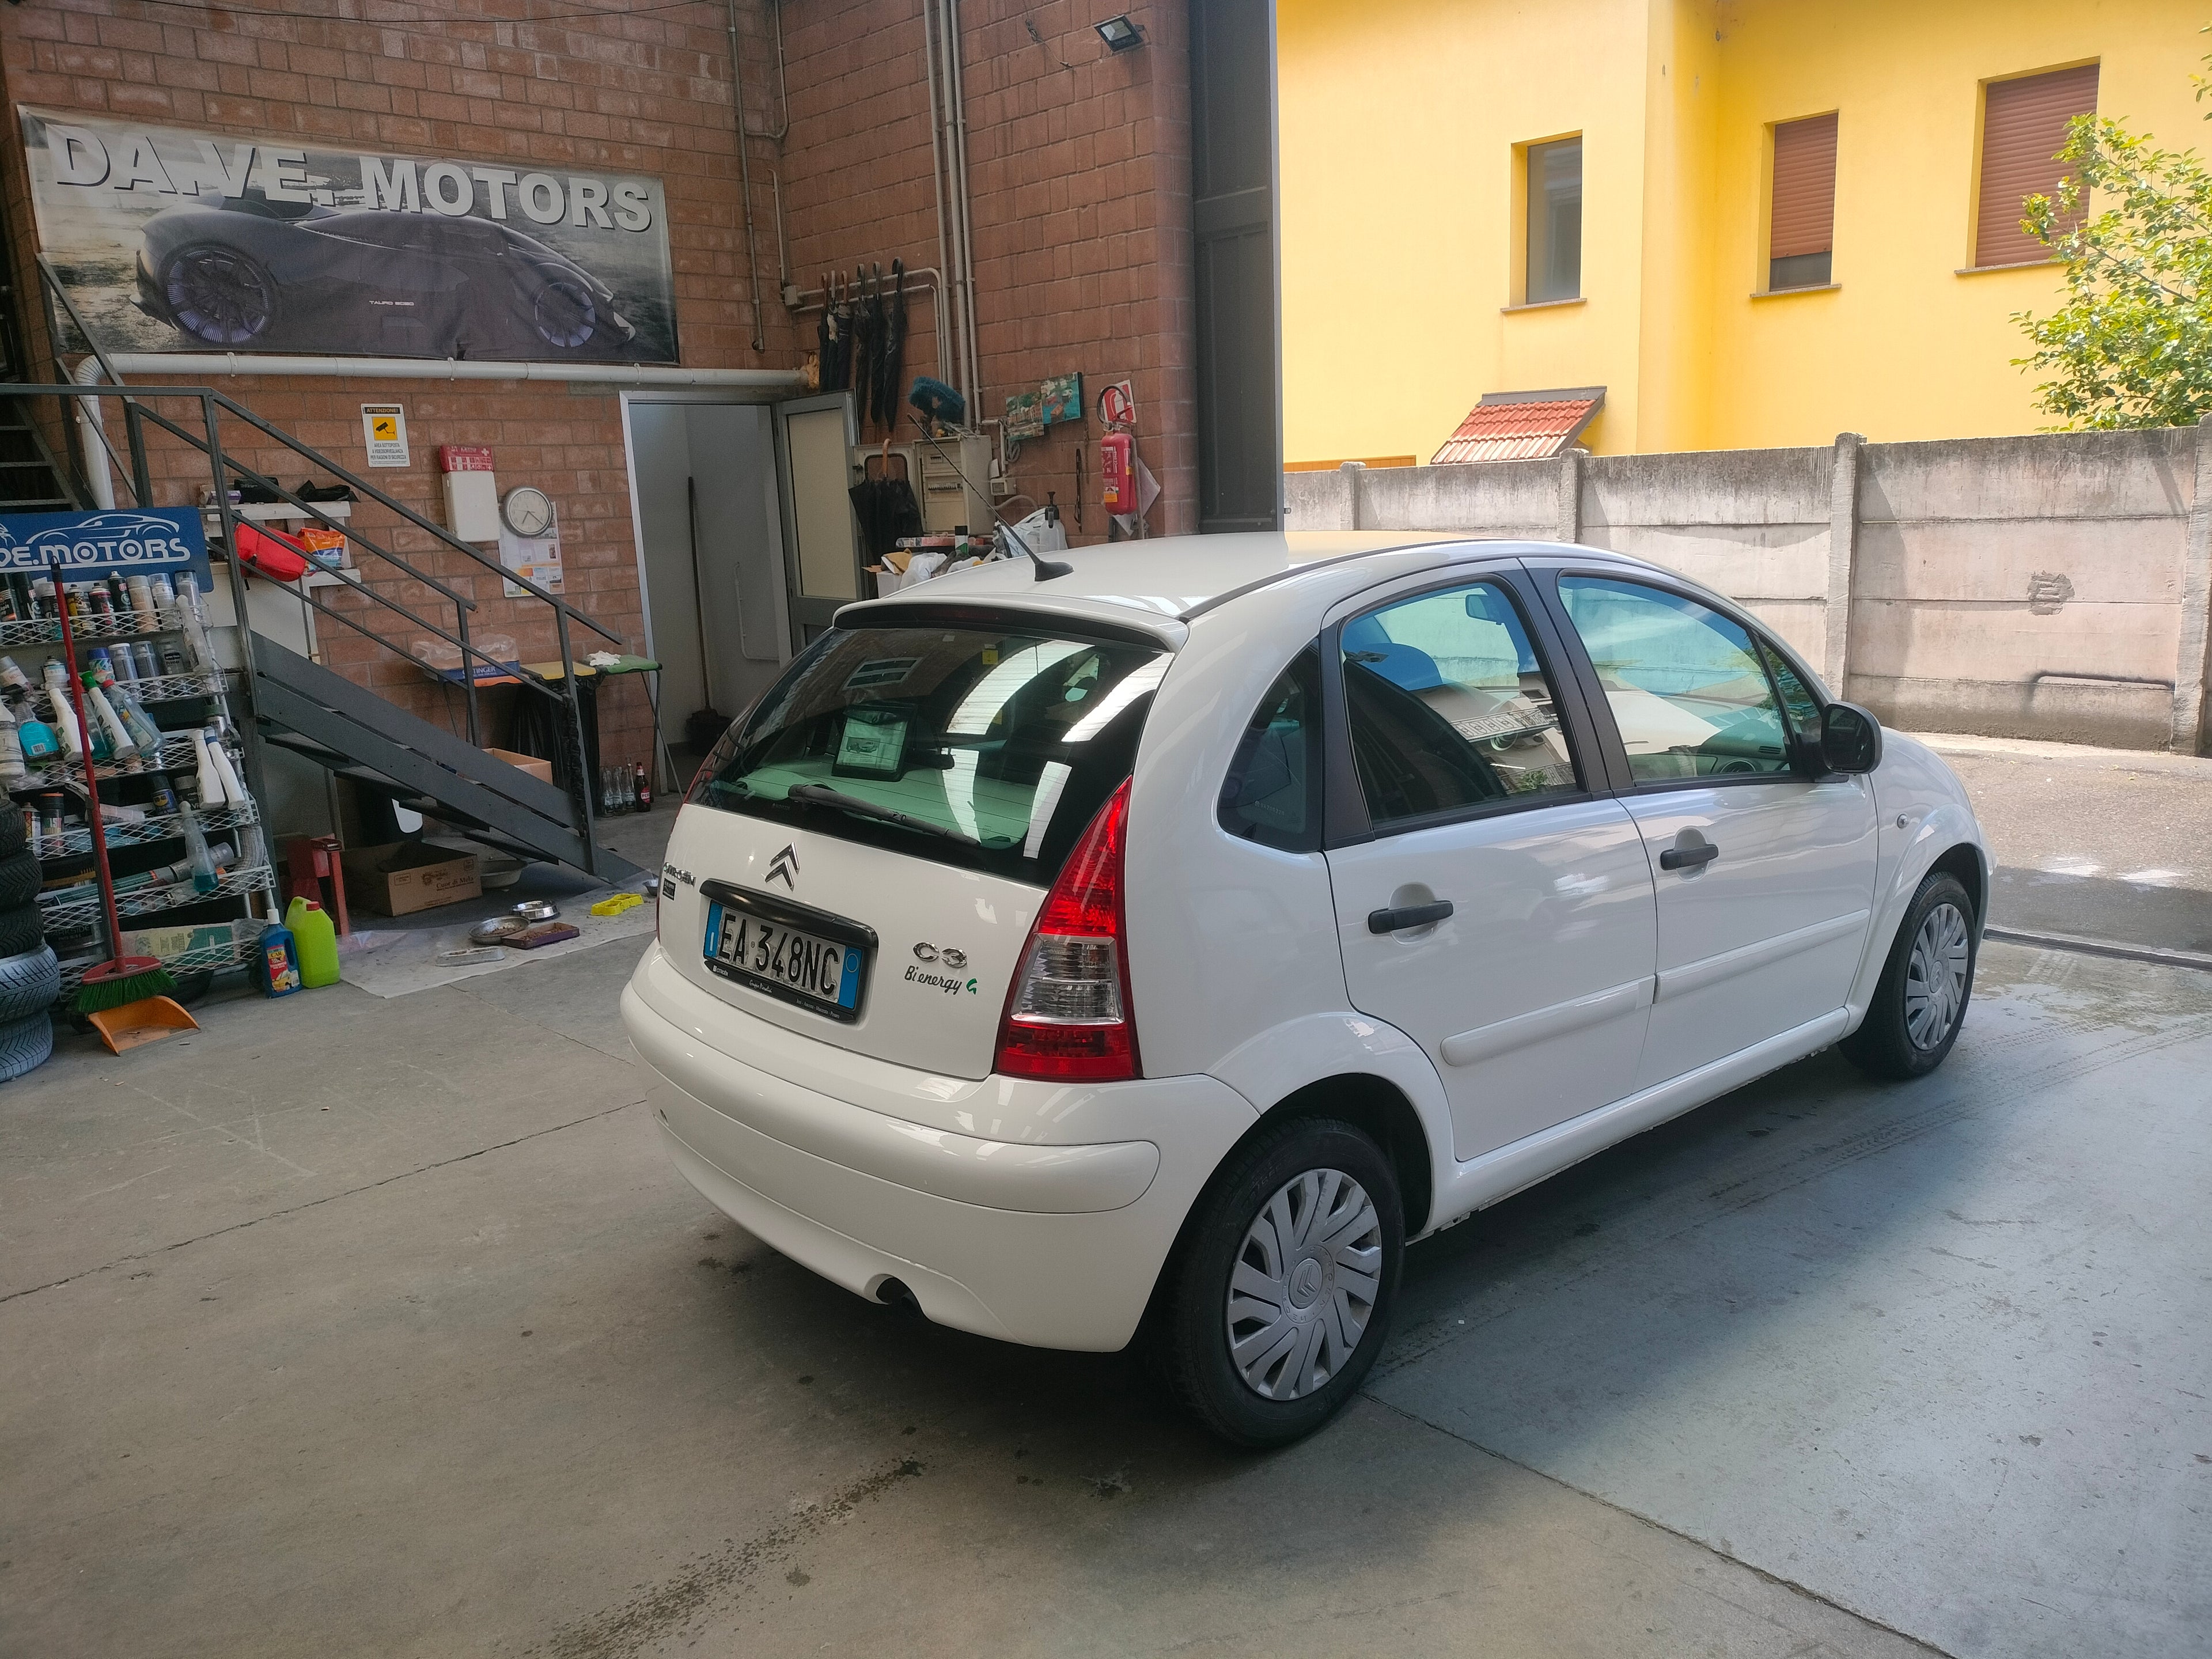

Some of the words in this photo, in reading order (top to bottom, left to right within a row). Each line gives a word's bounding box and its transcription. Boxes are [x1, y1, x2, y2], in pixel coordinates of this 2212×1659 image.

[359, 156, 652, 233] MOTORS
[719, 913, 747, 964] EA
[755, 924, 839, 995] 348NC
[912, 942, 968, 969] C3
